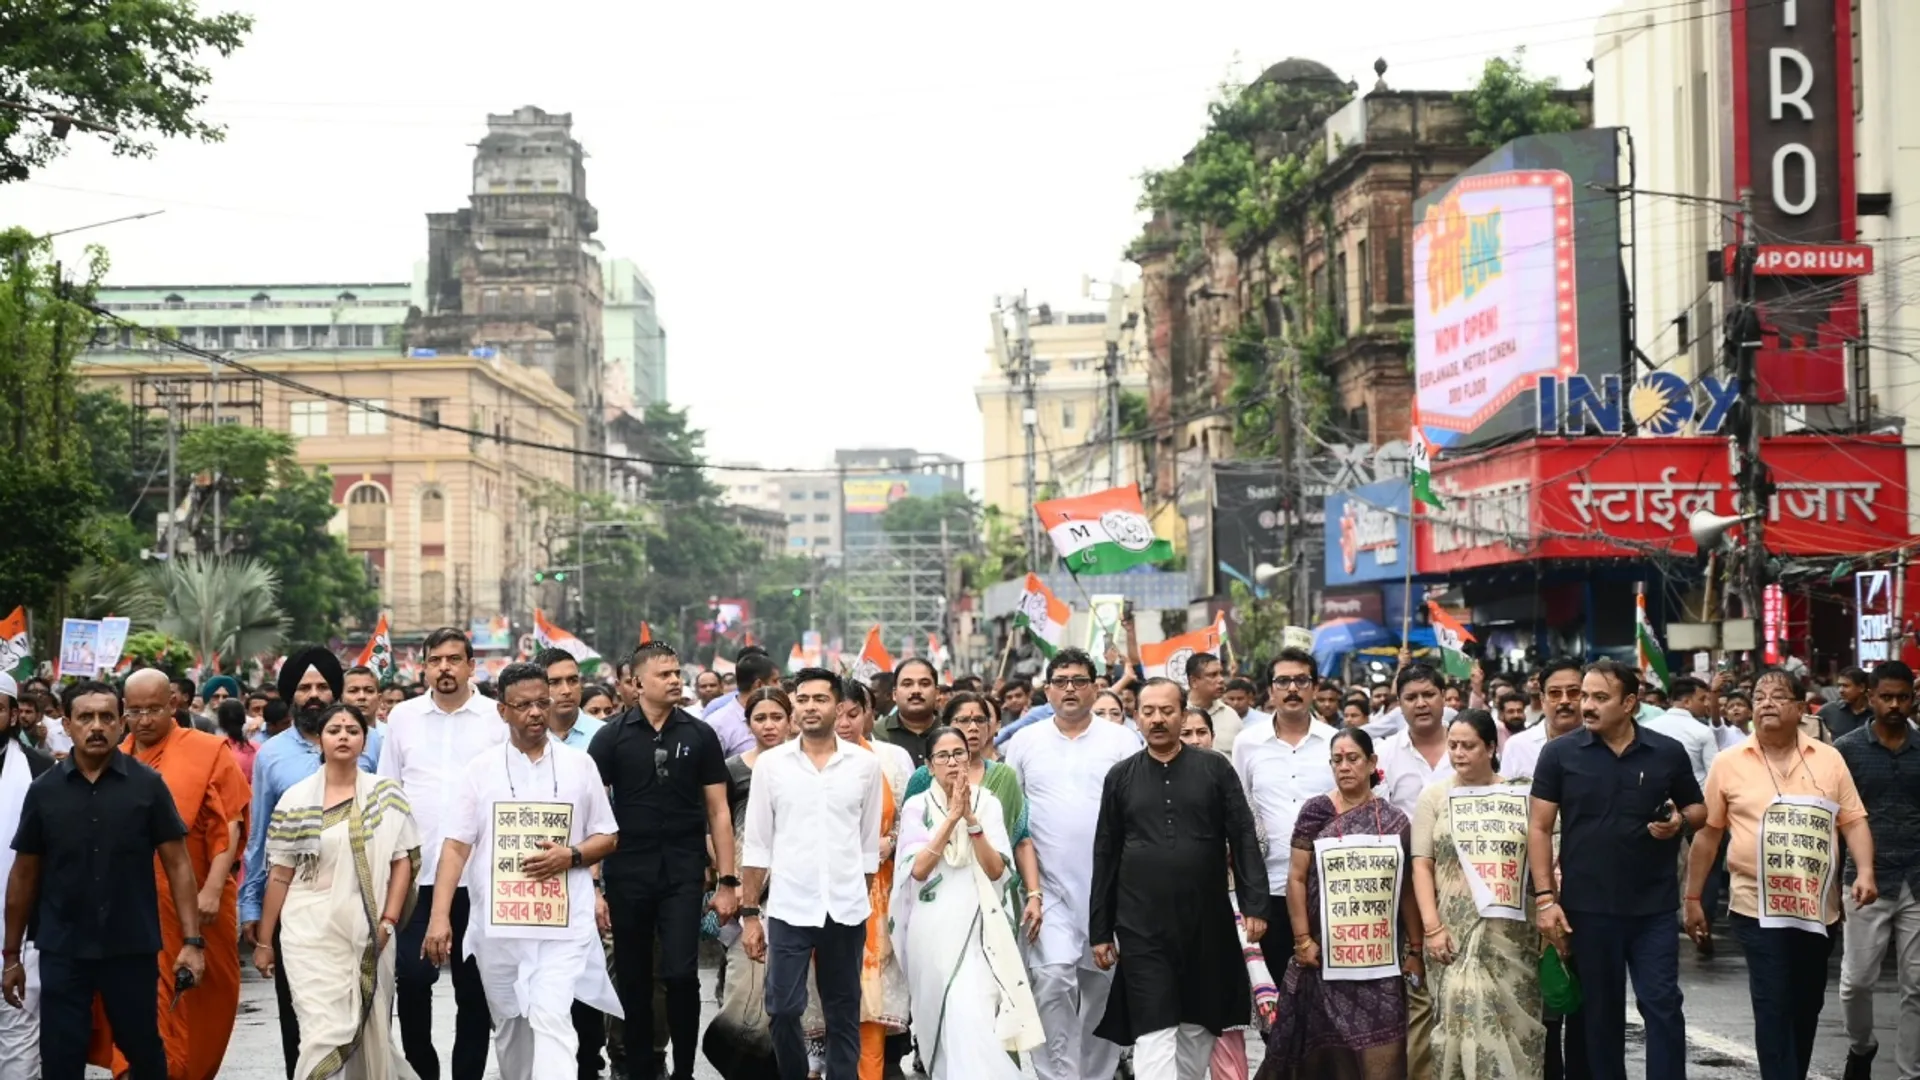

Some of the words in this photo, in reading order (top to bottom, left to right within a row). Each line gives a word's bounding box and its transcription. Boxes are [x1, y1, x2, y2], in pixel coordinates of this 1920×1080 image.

[1733, 252, 1865, 268] MPORIUM
[1567, 467, 1722, 531] स्टाईल
[1457, 820, 1479, 834] বাংলা
[498, 834, 521, 850] বাংলা
[1766, 831, 1789, 847] বাংলা
[1326, 856, 1345, 872] ডবল
[496, 880, 536, 897] জবাব
[1328, 878, 1351, 895] বাংলা
[1767, 875, 1803, 893] জবাব
[496, 902, 530, 920] জবাব
[1331, 901, 1347, 918] বলা
[1350, 896, 1360, 917] কি
[1768, 894, 1798, 914] জবাব
[1332, 923, 1369, 941] জবাব
[1332, 944, 1364, 964] জবাব
[1366, 943, 1383, 963] দাও
